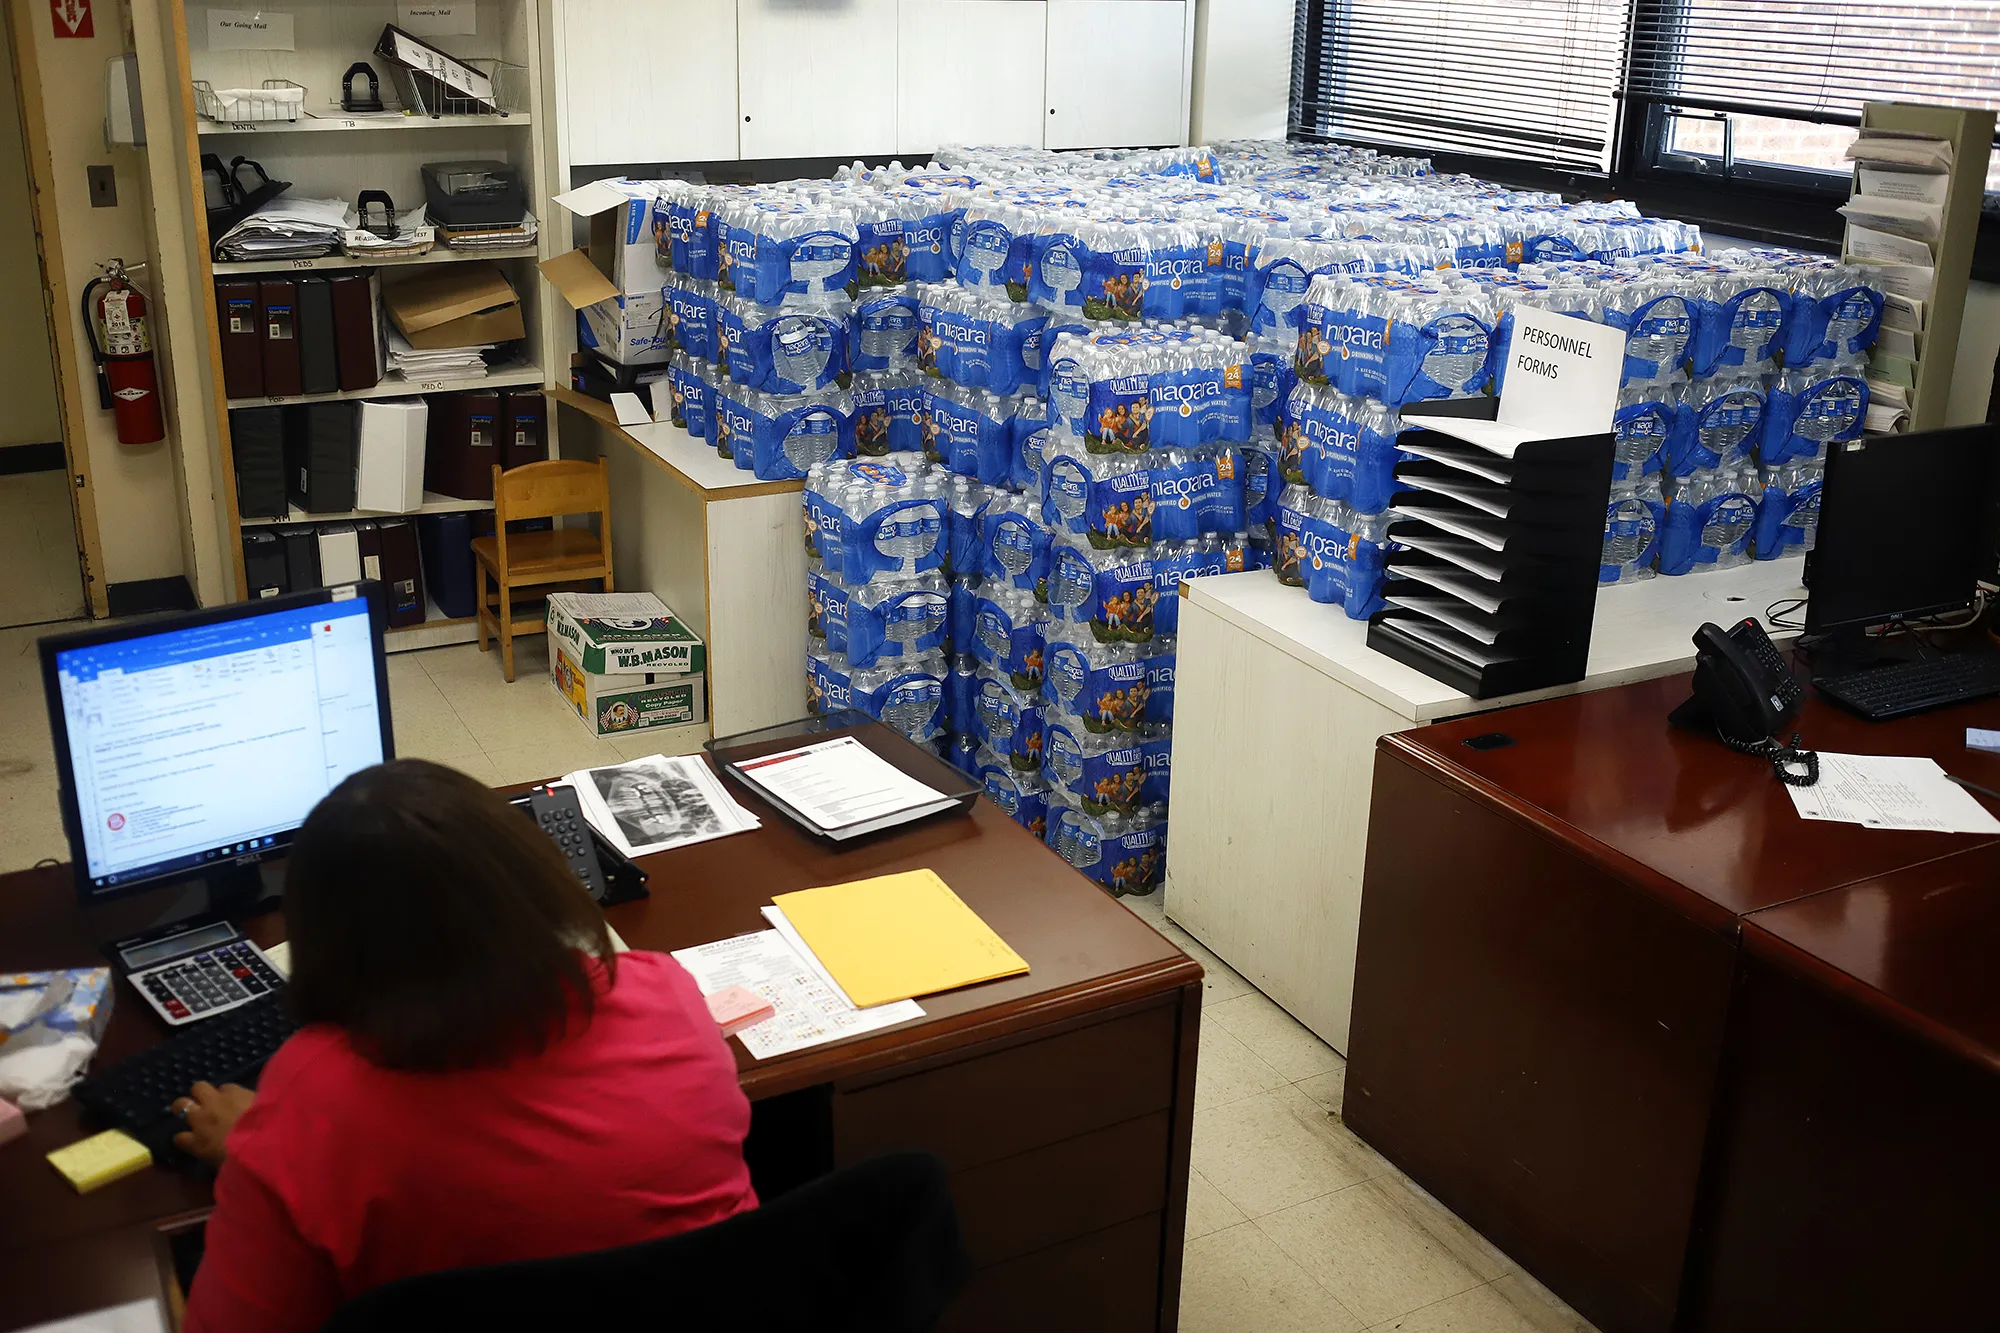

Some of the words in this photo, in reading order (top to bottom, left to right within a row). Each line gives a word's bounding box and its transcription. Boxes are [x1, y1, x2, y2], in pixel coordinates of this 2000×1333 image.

[1210, 249, 1221, 257] 24
[292, 260, 313, 268] PEDS
[1523, 326, 1592, 358] PERSONNEL
[1517, 354, 1559, 379] FORMS
[1227, 372, 1239, 381] 24
[1150, 380, 1221, 417] niagara
[1220, 463, 1232, 471] 24
[1151, 473, 1215, 510] niagara
[1229, 555, 1242, 563] 24
